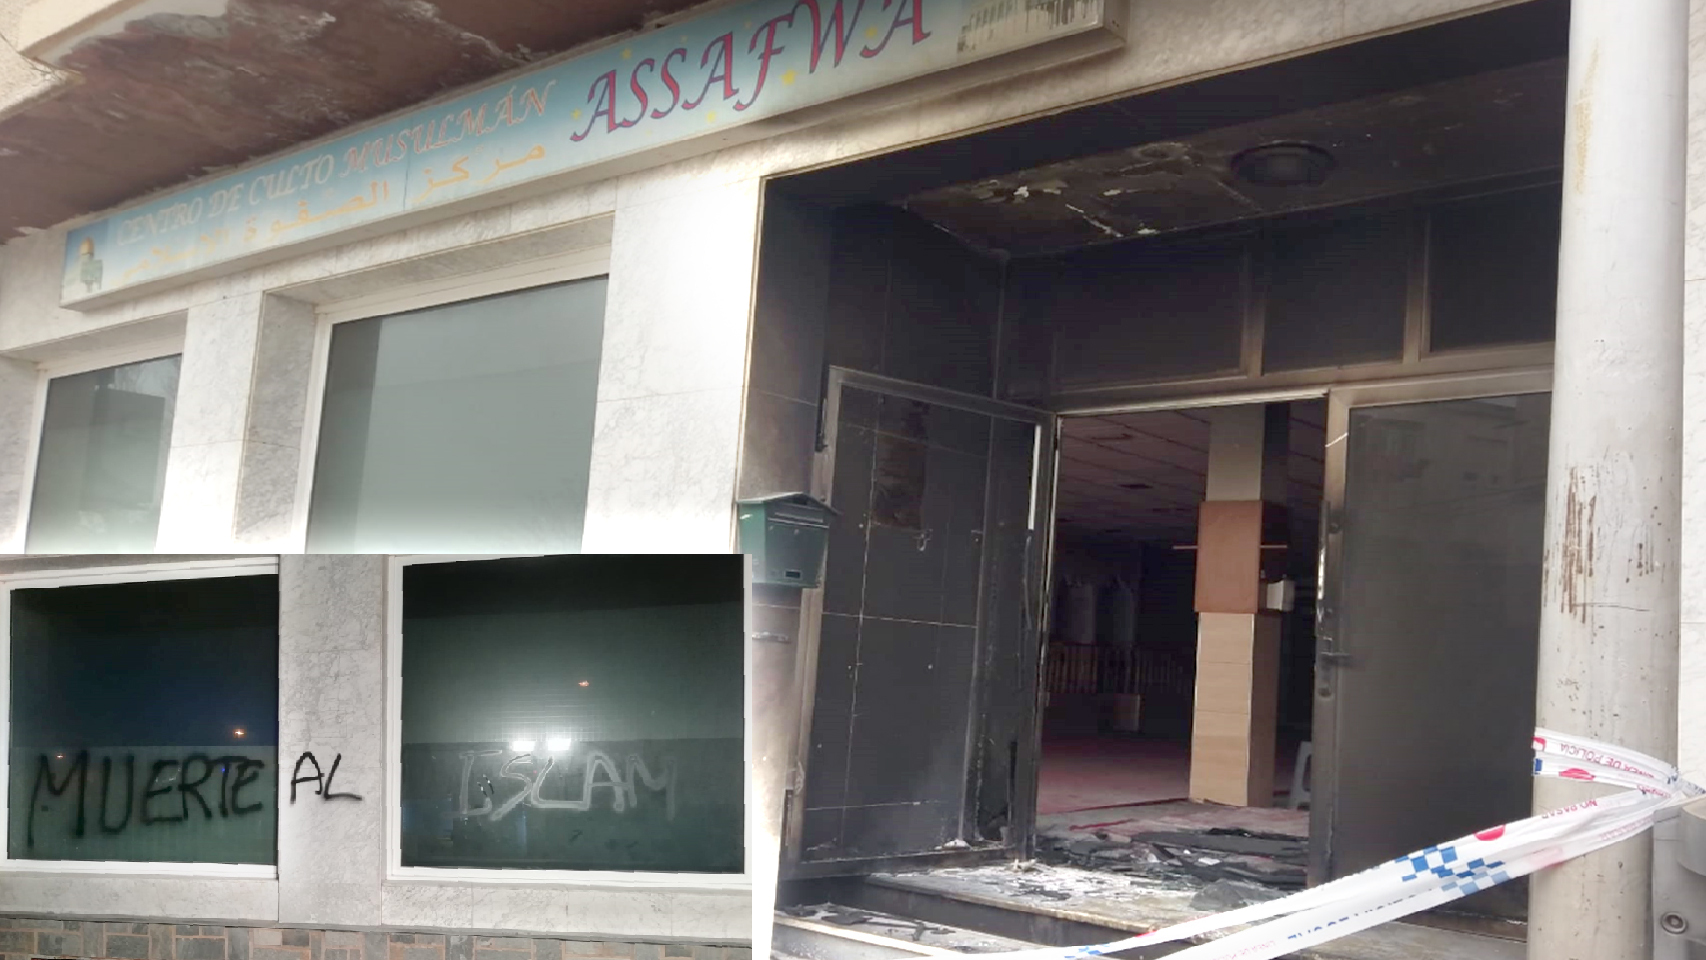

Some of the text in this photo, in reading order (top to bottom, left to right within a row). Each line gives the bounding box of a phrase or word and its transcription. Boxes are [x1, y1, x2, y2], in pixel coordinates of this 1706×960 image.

[570, 0, 932, 142] ASSAFWA
[115, 79, 559, 248] CENTRO DE CULTO MUSULMÁN
[26, 748, 364, 849] MUERTE AL
